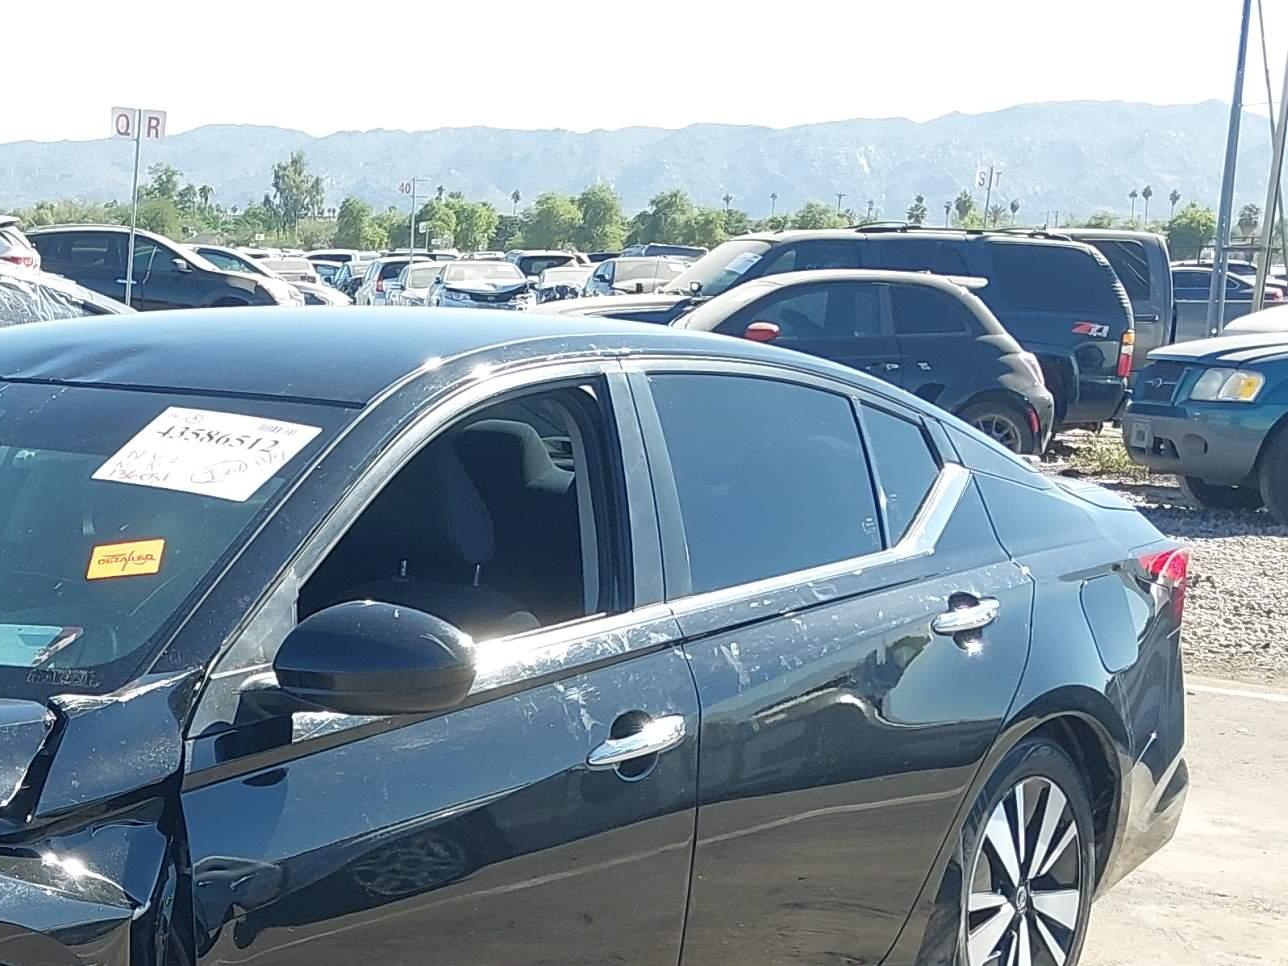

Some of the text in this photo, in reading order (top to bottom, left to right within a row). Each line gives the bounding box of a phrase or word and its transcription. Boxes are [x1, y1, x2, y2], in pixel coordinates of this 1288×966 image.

[115, 113, 131, 136] Q
[146, 116, 160, 138] R
[399, 182, 411, 194] 40
[978, 171, 986, 187] S
[995, 171, 1002, 187] T
[156, 425, 280, 453] 43586512
